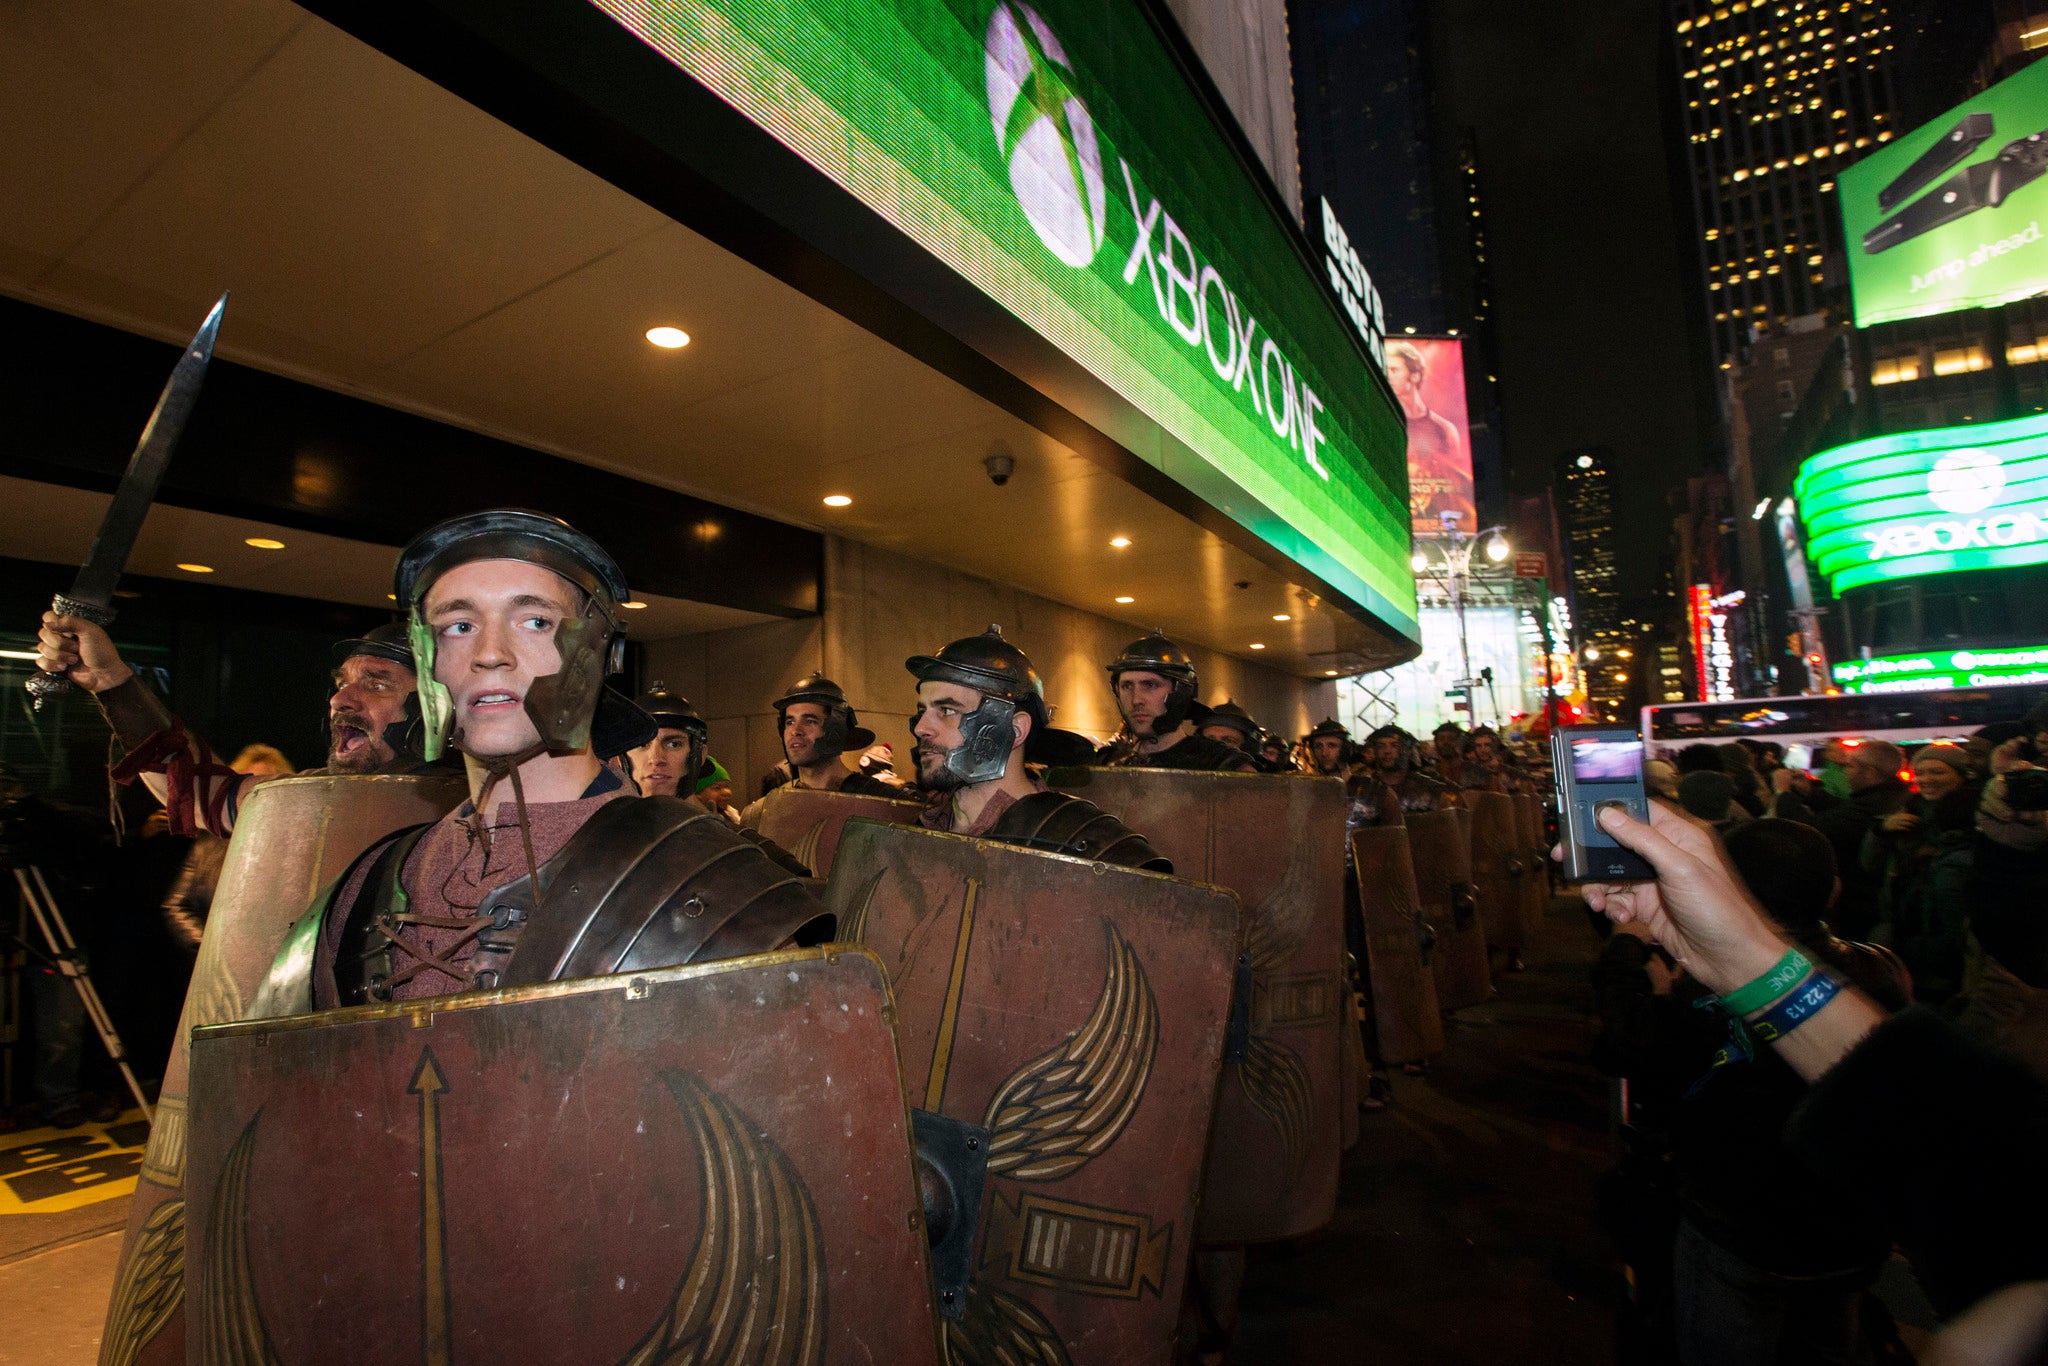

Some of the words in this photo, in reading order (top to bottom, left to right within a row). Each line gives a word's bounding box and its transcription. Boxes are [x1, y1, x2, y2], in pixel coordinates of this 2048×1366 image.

[1321, 195, 1372, 315] BEST
[1909, 258, 1966, 293] Jump
[1119, 157, 1262, 415] XBOX
[1260, 338, 1329, 480] ONE
[1863, 518, 1989, 560] XBOX
[1985, 508, 2048, 547] ON
[1766, 965, 1797, 992] ONE
